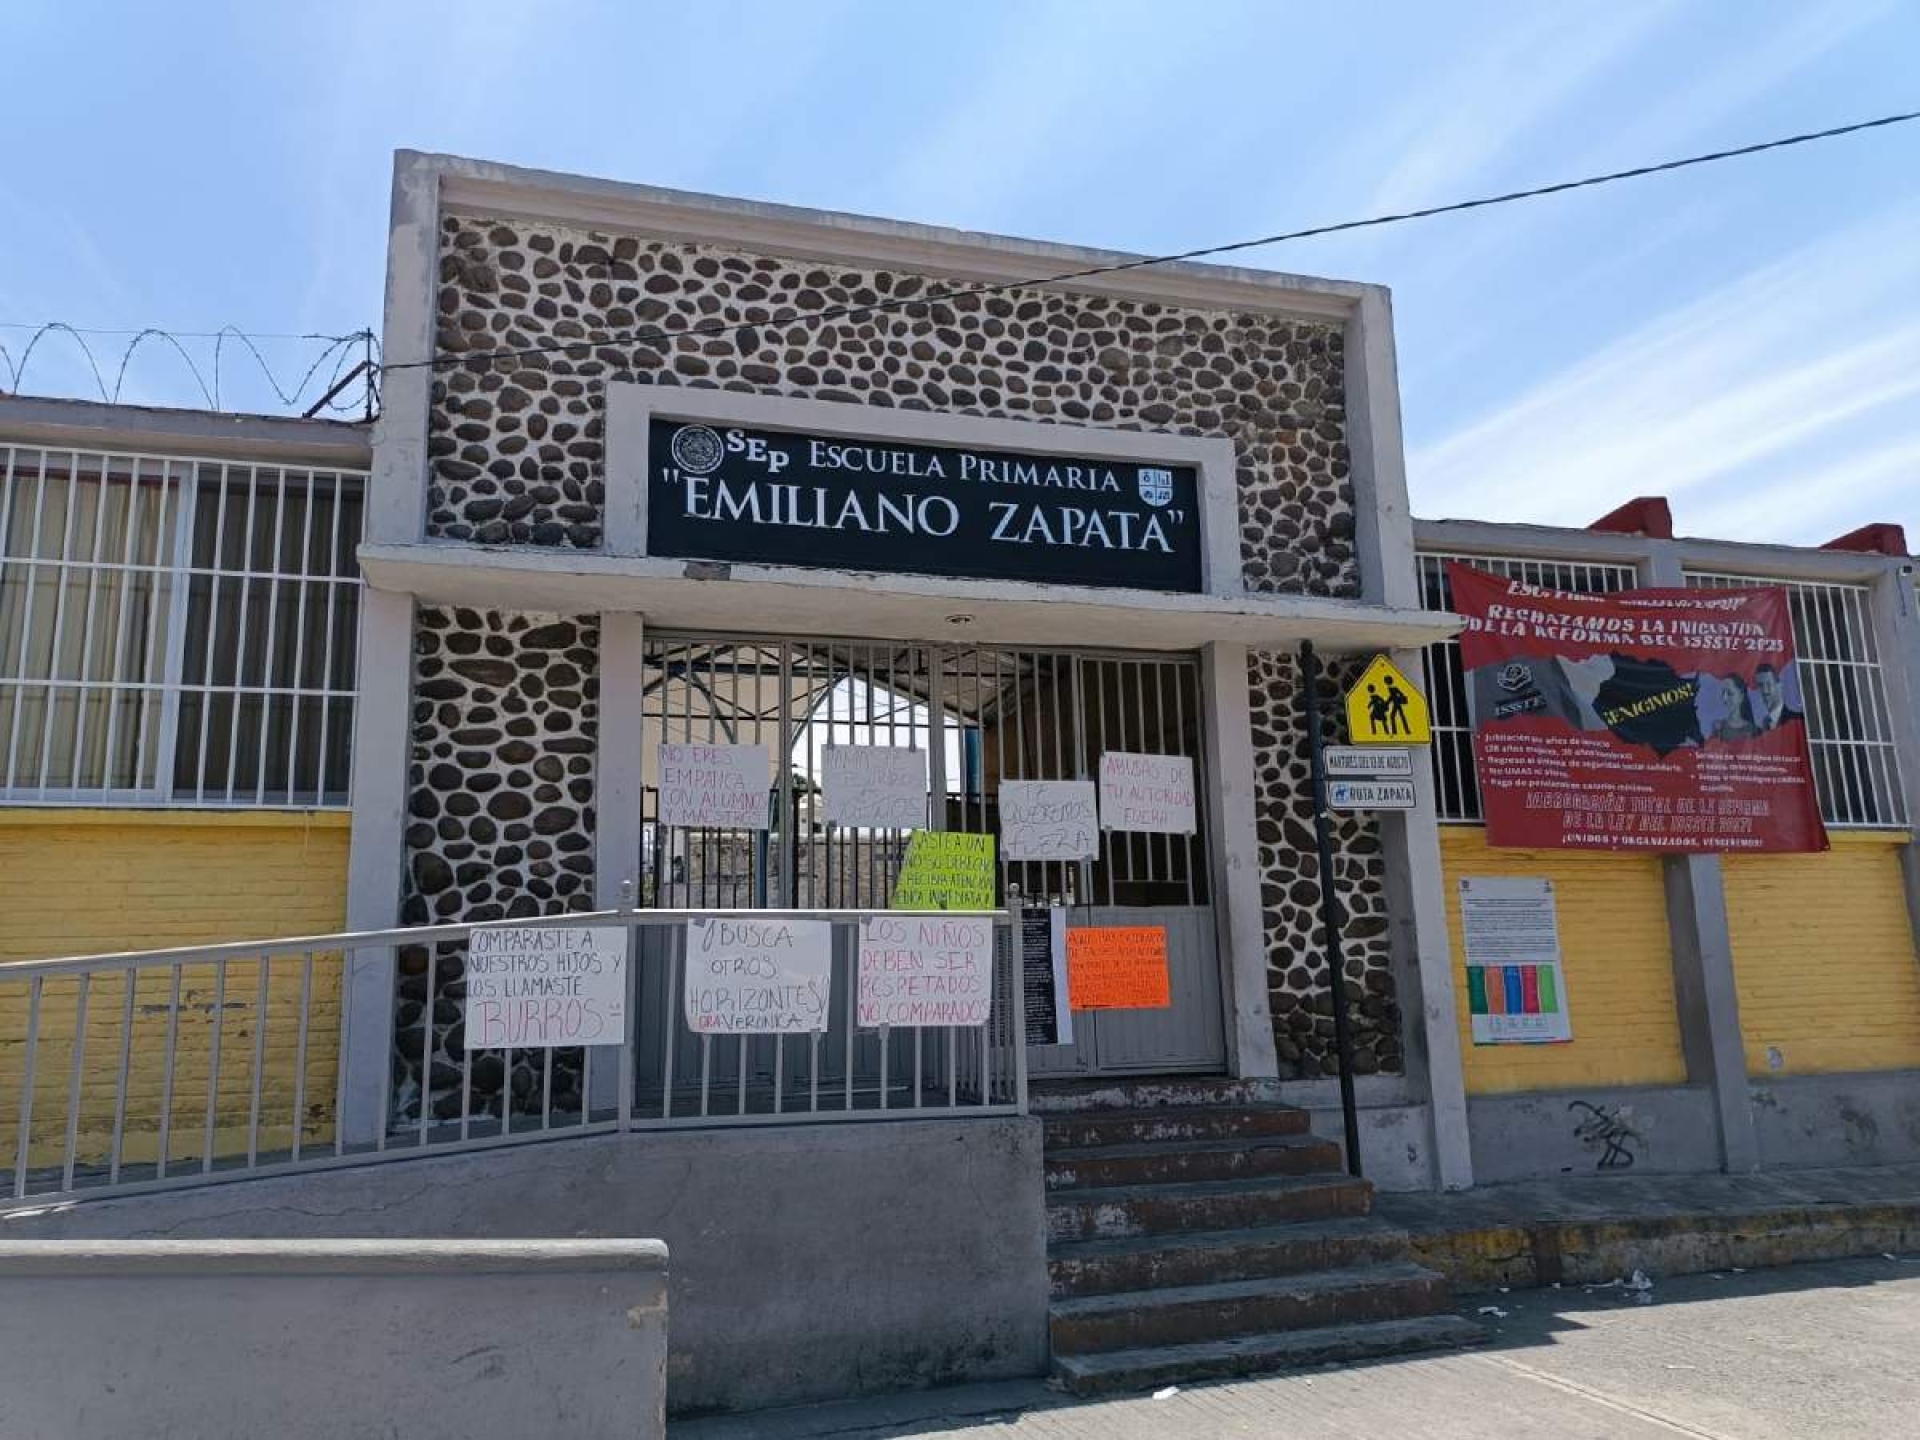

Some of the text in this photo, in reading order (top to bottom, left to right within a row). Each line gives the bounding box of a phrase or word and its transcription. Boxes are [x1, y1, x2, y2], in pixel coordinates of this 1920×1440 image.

[726, 428, 789, 473] SEP
[809, 440, 1121, 493] ESCUELA PRIMARIA
[663, 468, 1185, 553] "EMILIANO ZAPATA"
[1641, 619, 1665, 634] LA
[1350, 785, 1412, 801] RUTA ZAPATA
[471, 928, 593, 953] COMPARASTE A
[866, 919, 985, 949] LOS NIÑOS
[470, 949, 622, 975] NUESTROS HIJOS Y
[711, 955, 778, 979] OTROS
[863, 949, 977, 972] DEBEN SER
[468, 975, 585, 998] LOS LLAMASTE
[860, 974, 981, 999] RESPETADOS
[859, 1000, 880, 1023] NO
